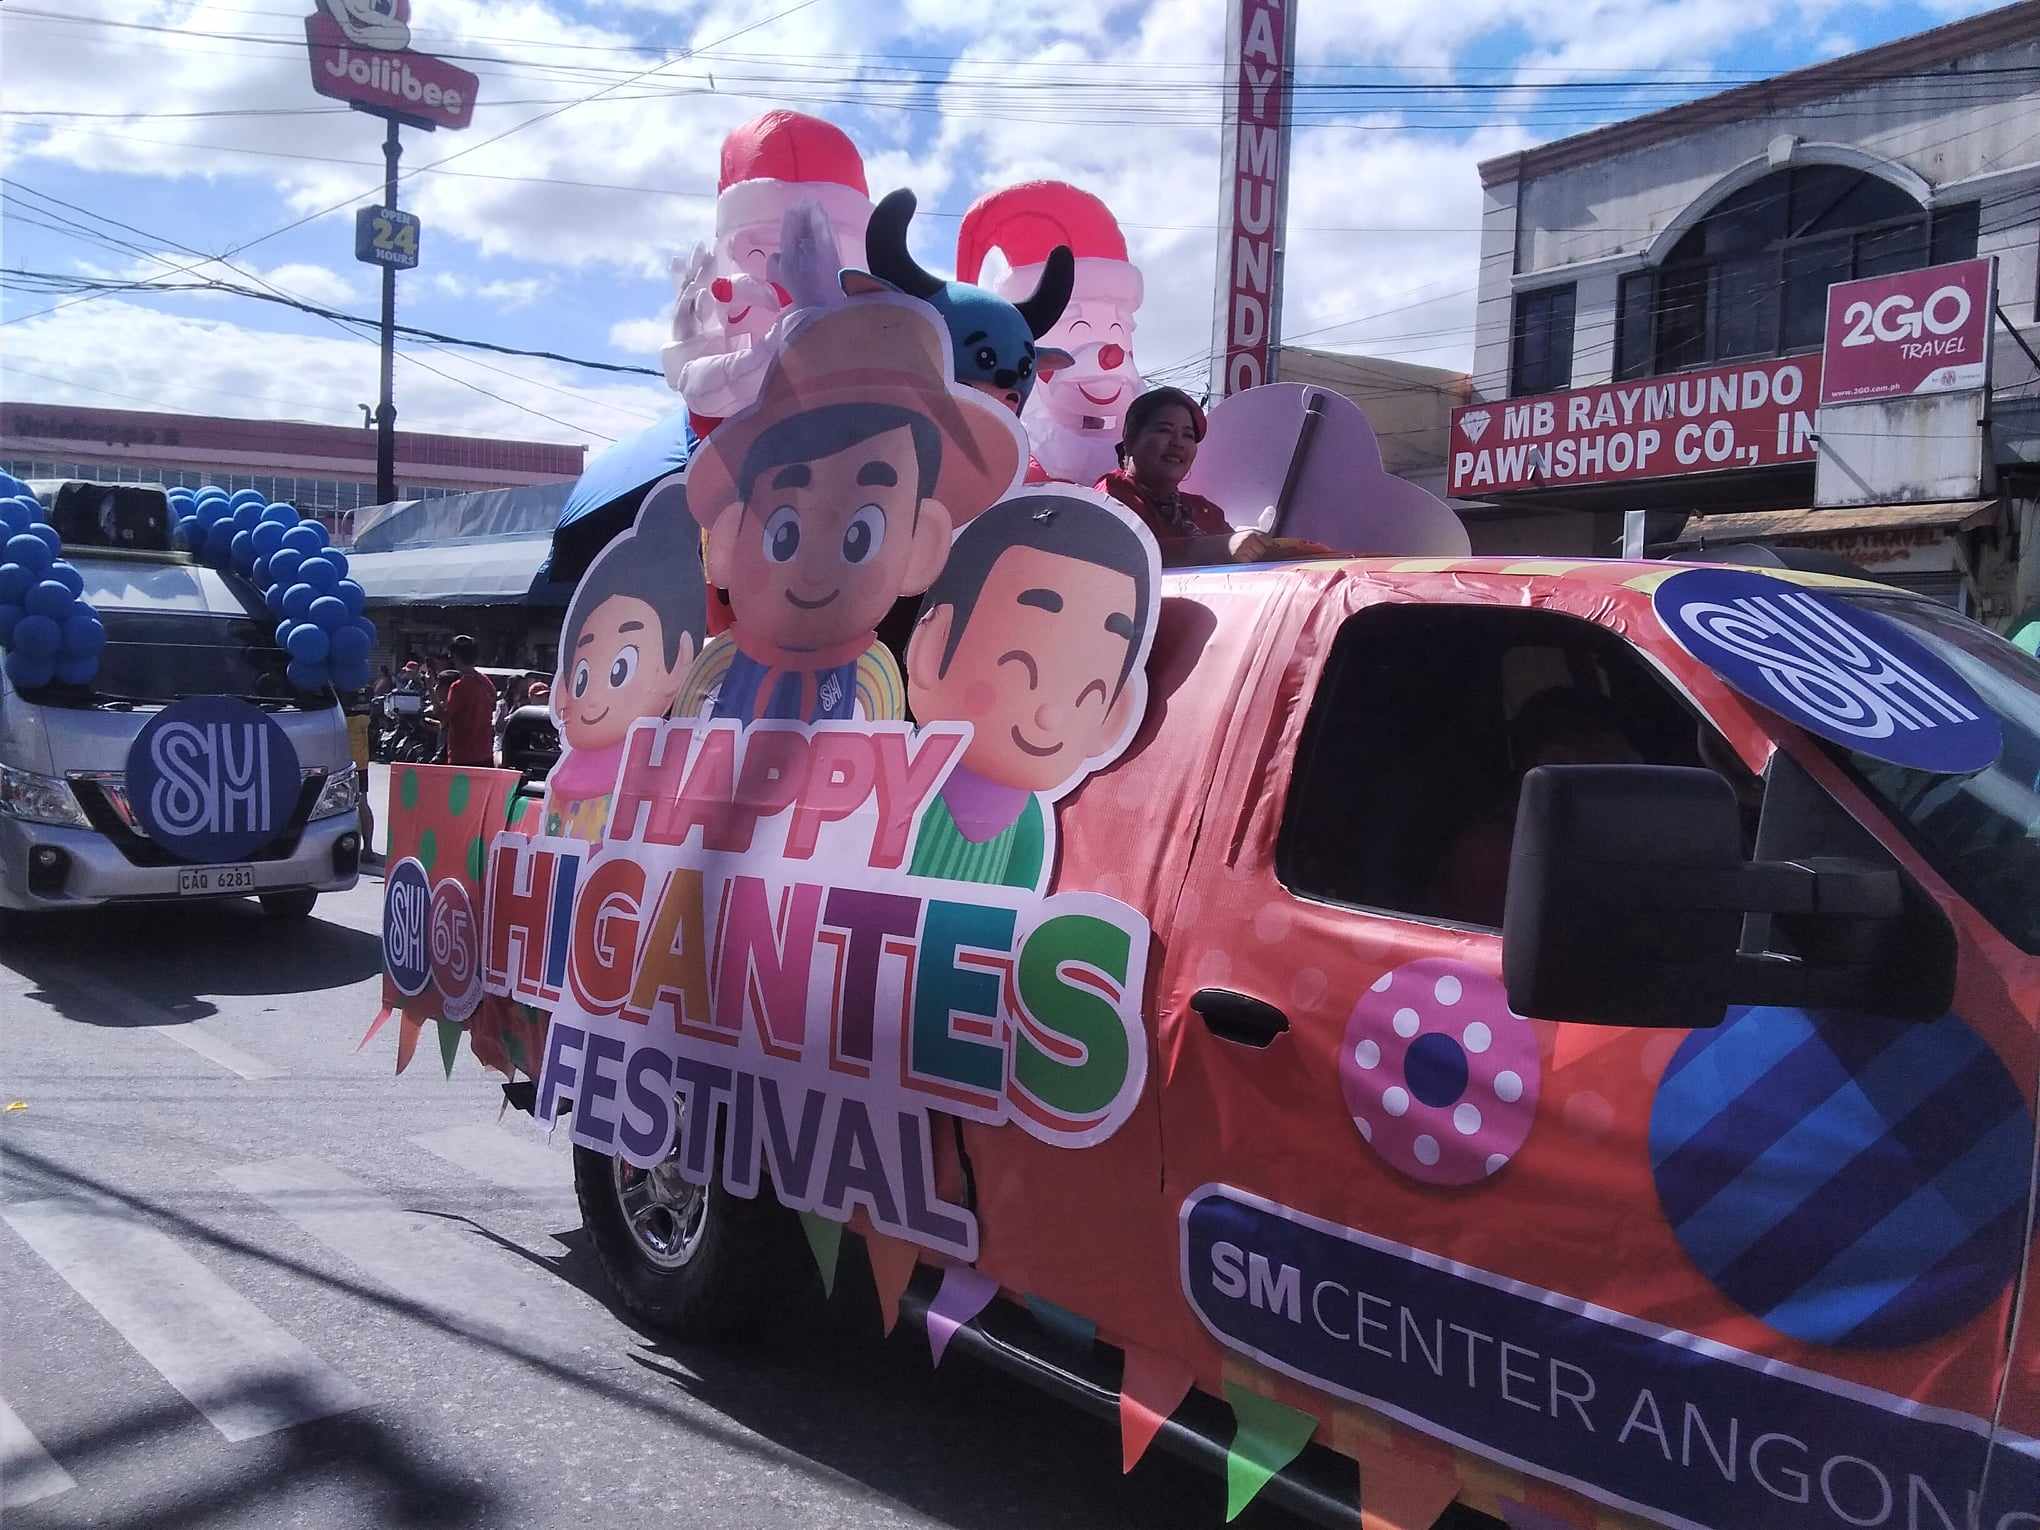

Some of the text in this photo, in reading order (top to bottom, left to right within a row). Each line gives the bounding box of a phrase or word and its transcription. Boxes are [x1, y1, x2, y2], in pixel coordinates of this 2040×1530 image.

[325, 47, 463, 115] Jollibee
[380, 208, 410, 225] OPEN
[1229, 0, 1281, 394] AYMUNDO
[372, 217, 418, 256] 24
[376, 248, 416, 265] HOURS
[1841, 285, 1972, 347] 2GO
[1900, 336, 1966, 360] TRAVEL
[1503, 365, 1803, 440] MB RAYMUNDO
[1831, 382, 1901, 398] www.2GO.com.ph
[1453, 429, 1661, 488] PAWNSHOP
[1674, 420, 1759, 467] CO.,
[151, 721, 271, 836] SM
[609, 727, 958, 870] HAPPY
[217, 871, 252, 888] 6281
[431, 896, 469, 982] 65
[488, 846, 1133, 1131] HIGANTES
[538, 1022, 971, 1249] FESTIVAL
[1210, 1240, 2040, 1530] SM CENTER ANGON
